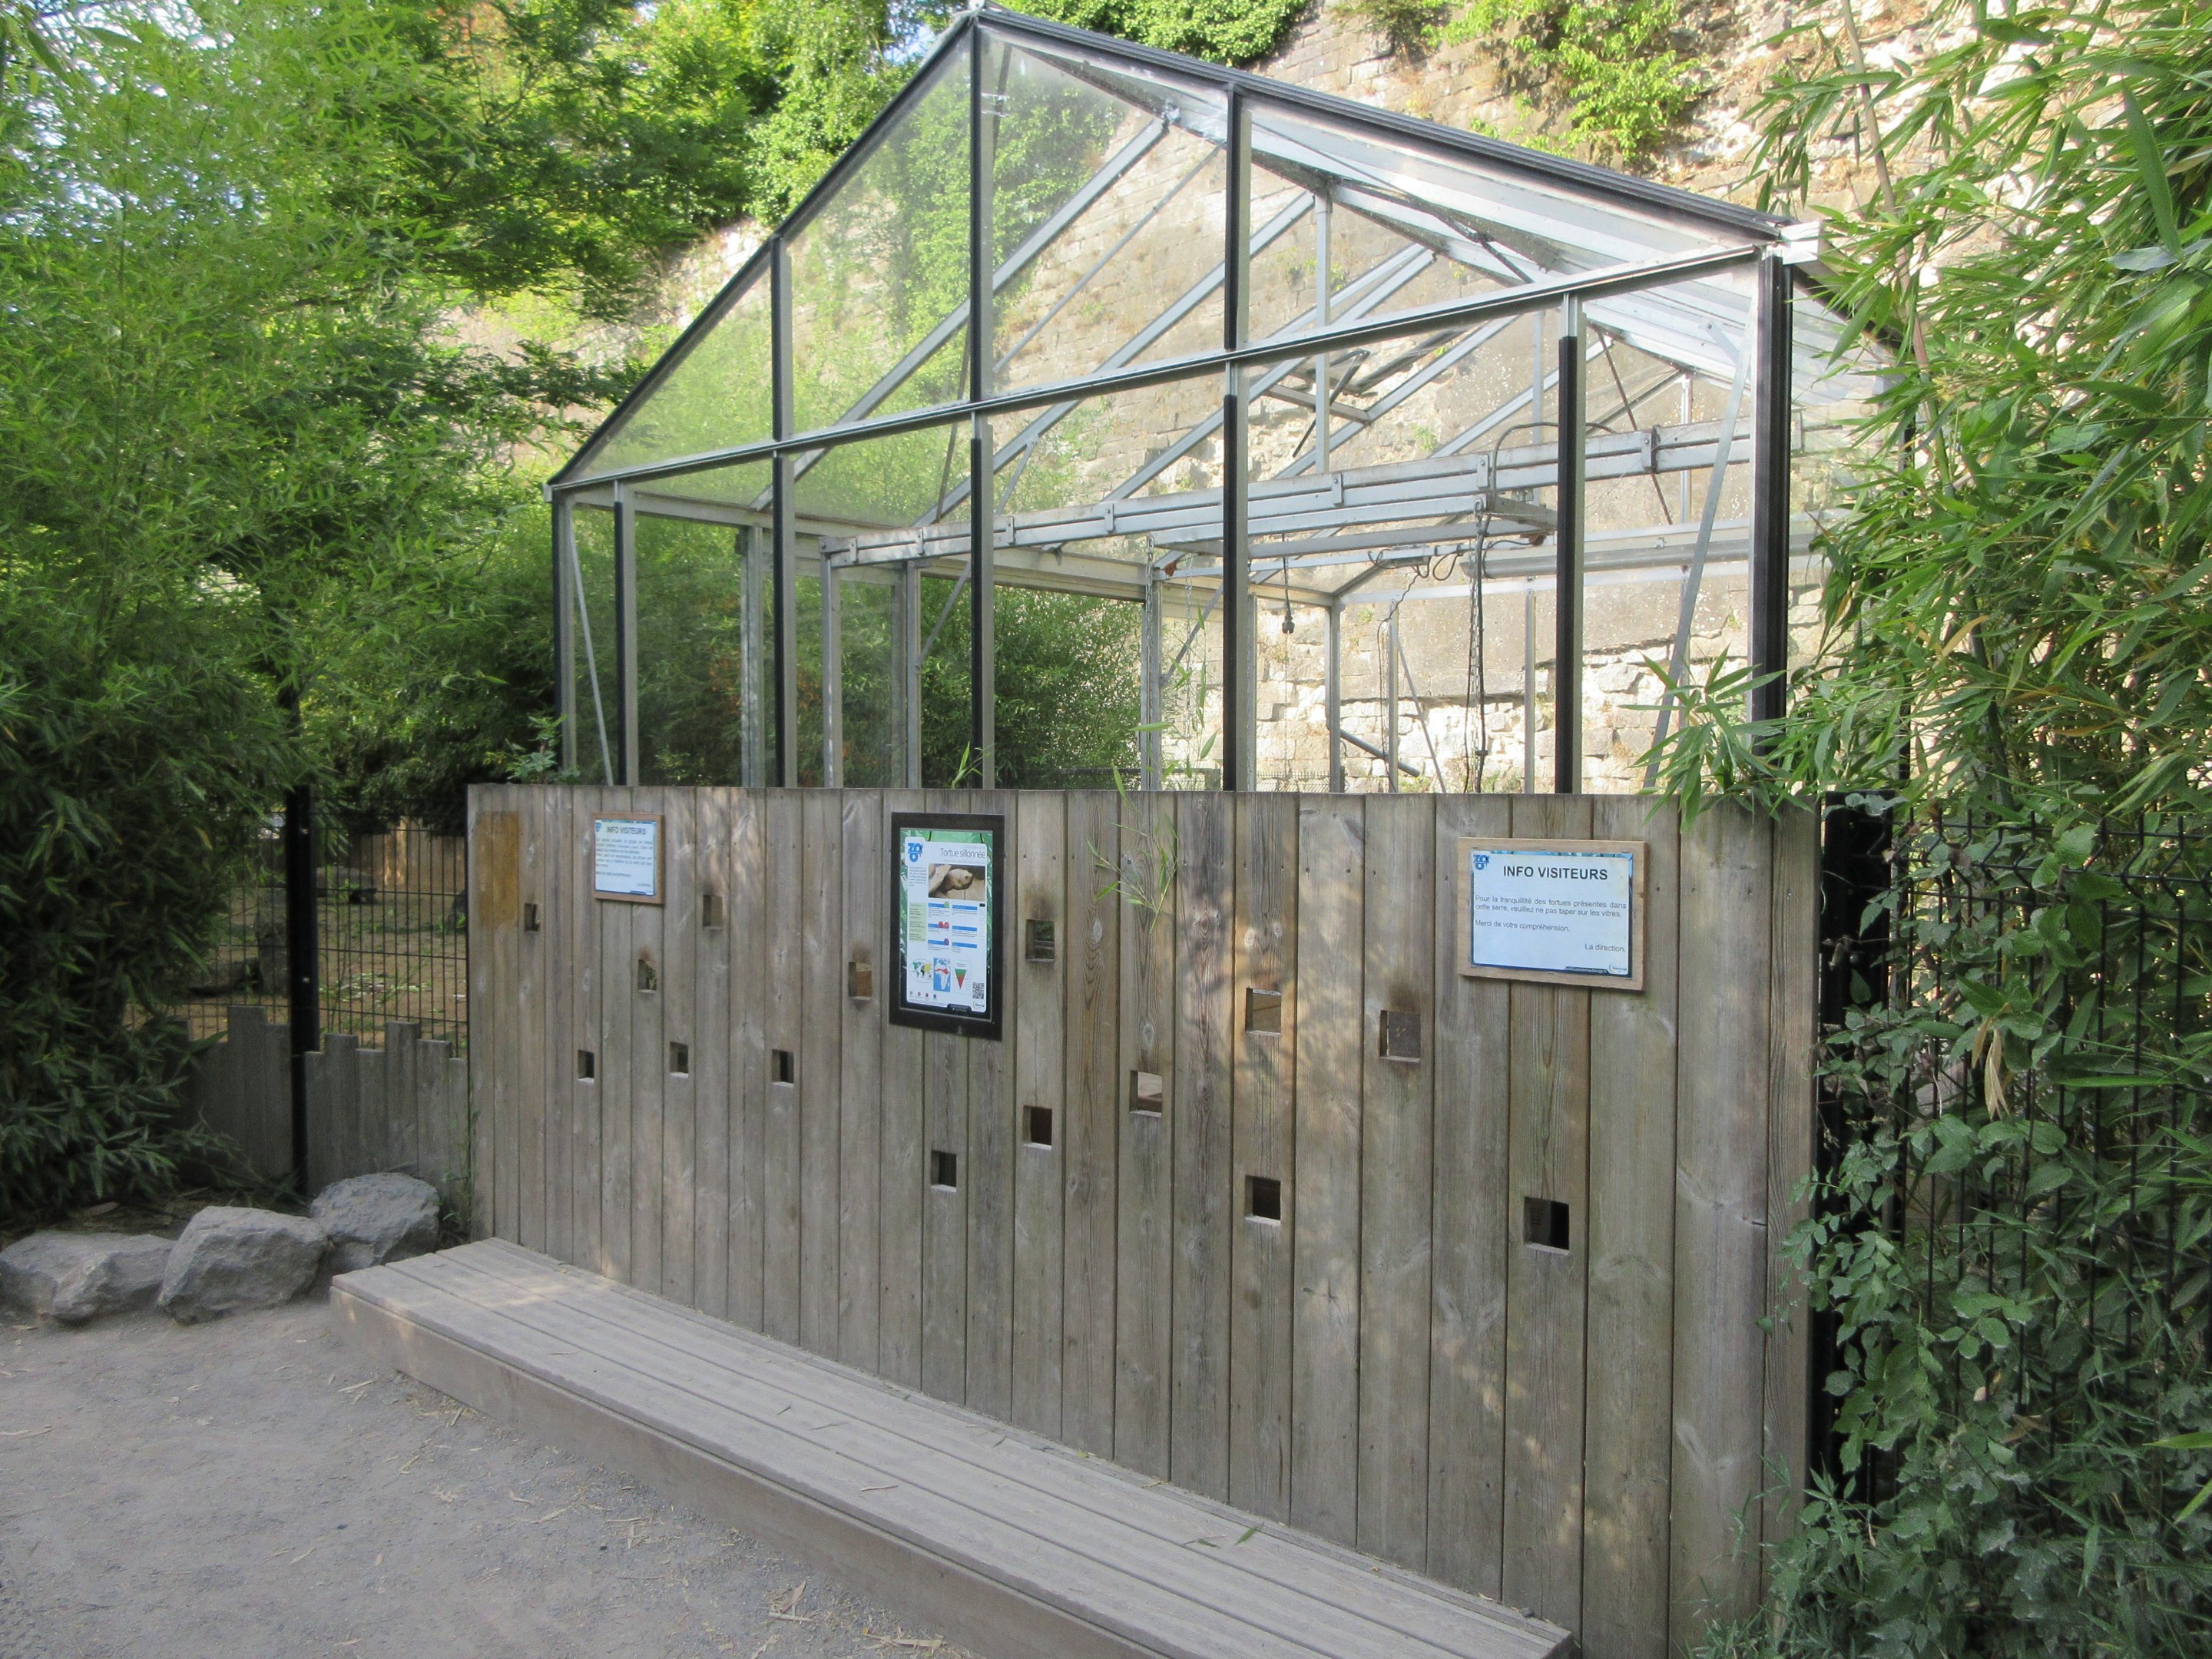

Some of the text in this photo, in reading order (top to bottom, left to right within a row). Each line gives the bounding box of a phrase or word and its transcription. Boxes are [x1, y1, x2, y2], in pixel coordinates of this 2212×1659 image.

[940, 848, 985, 859] Tortue sillonnée
[1503, 866, 1608, 880] INFO VISITEURS
[1519, 922, 1571, 932] compréhension.
[1594, 944, 1627, 952] direction.
